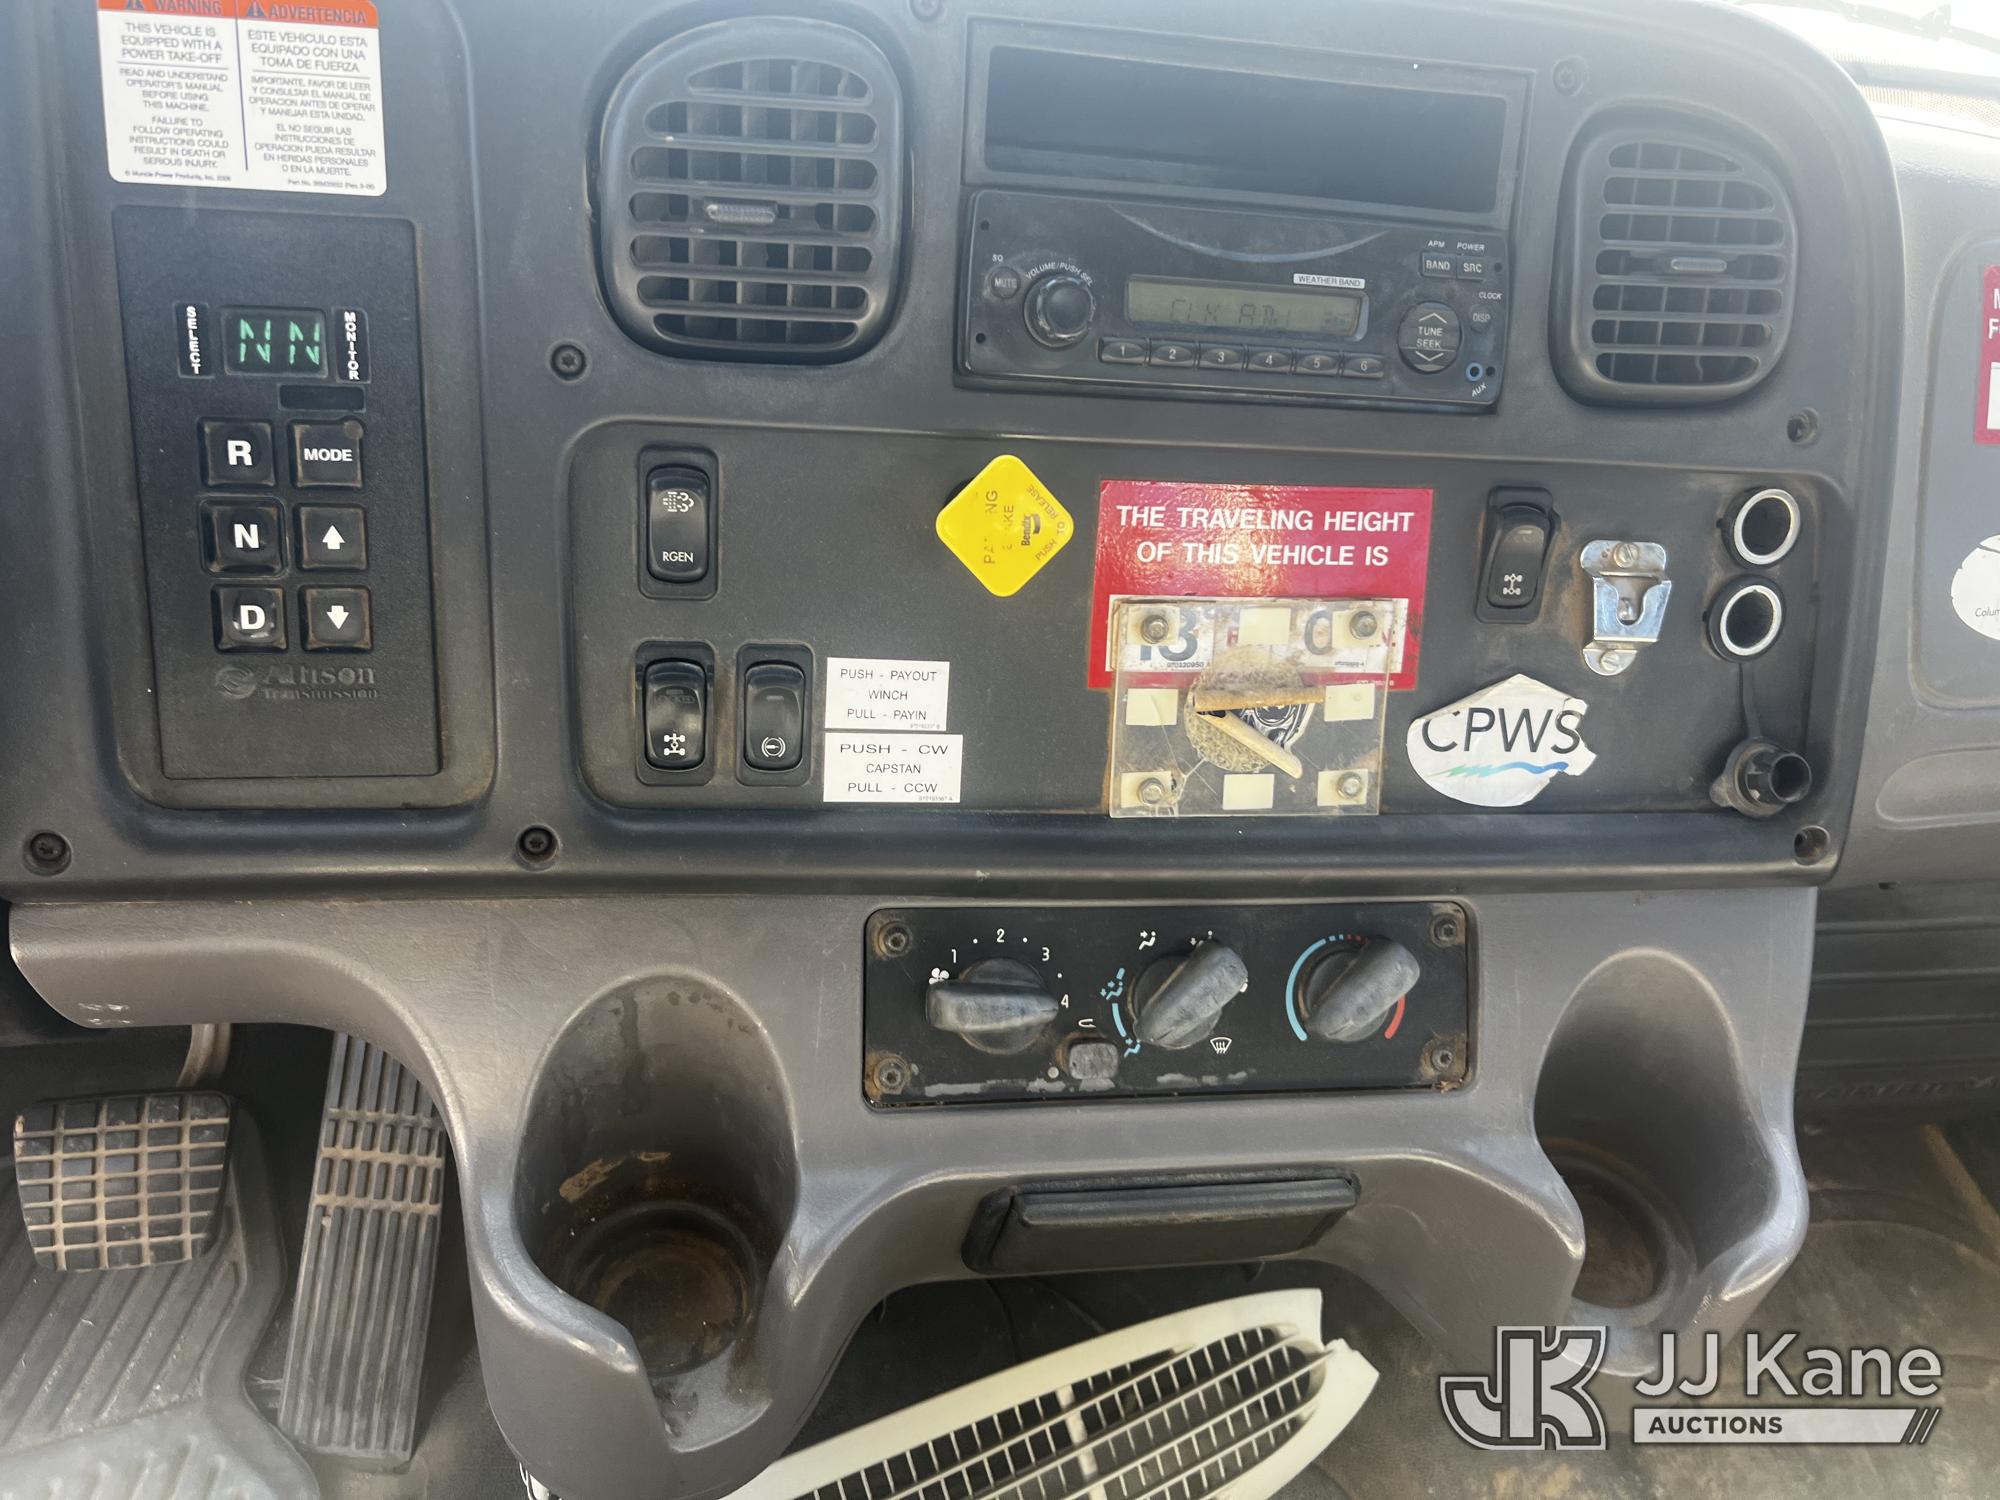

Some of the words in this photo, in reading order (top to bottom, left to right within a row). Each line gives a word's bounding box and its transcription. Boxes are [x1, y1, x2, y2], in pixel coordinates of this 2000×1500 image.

[270, 4, 367, 23] ADVERTENCIA
[125, 22, 152, 34] THIS
[154, 23, 201, 37] VEHICLE
[205, 26, 216, 38] IS
[120, 35, 180, 48] EQUIPPED
[183, 38, 211, 50] WITH
[214, 40, 222, 51] A
[248, 29, 277, 41] ESTE
[340, 36, 368, 48] ESTA
[121, 48, 165, 60] POWER
[166, 51, 222, 64] TAKE-OFF
[251, 43, 310, 57] EQUIPADO
[313, 46, 338, 58] CON
[341, 49, 366, 61] UNA
[260, 56, 294, 68] TOMA
[297, 59, 312, 69] DE
[315, 60, 360, 73] FUERZA
[120, 68, 144, 77] READ
[146, 69, 165, 79] AND
[167, 71, 228, 82] UNDERSTAND
[126, 79, 182, 90] OPERATOR'S
[185, 82, 223, 92] MANUAL
[308, 79, 335, 89] FAVOR
[337, 80, 348, 90] DE
[349, 82, 370, 92] LEER
[142, 90, 178, 100] BEFORE
[180, 91, 209, 102] USING
[252, 87, 258, 95] Y
[260, 87, 309, 97] CONSULTAR
[311, 89, 321, 98] EL
[323, 90, 356, 100] MANUAL
[359, 92, 370, 102] DE
[142, 100, 163, 109] THIS
[249, 96, 299, 107] OPERACION
[300, 99, 327, 109] ANTES
[328, 100, 339, 110] DE
[341, 101, 376, 112] OPERAR
[260, 107, 266, 115] Y
[268, 107, 309, 117] MANEJAR
[310, 110, 330, 119] ESTA
[332, 111, 365, 121] UNIDAD.
[152, 116, 188, 126] FAILURE
[191, 118, 203, 127] TO
[133, 125, 170, 135] FOLLOW
[172, 127, 223, 138] OPERATING
[276, 123, 286, 132] EL
[289, 124, 301, 133] NO
[303, 125, 334, 135] SEGUIR
[336, 127, 352, 136] LAS
[129, 136, 195, 147] INSTRUCTIONS
[197, 138, 229, 149] COULD
[275, 133, 341, 145] INSTRUCCIONES
[344, 137, 355, 146] DE
[134, 146, 167, 155] RESULT
[170, 147, 179, 156] IN
[181, 148, 210, 158] DEATH
[211, 149, 226, 159] OR
[254, 142, 303, 153] OPERACION
[305, 144, 334, 155] PUEDA
[335, 146, 376, 158] RESULTAR
[143, 157, 182, 167] SERIOUS
[264, 153, 275, 162] EN
[277, 153, 312, 164] HERIDAS
[314, 156, 369, 167] PERSONALES
[281, 164, 289, 172] O
[291, 165, 302, 173] EN
[303, 166, 314, 175] LA
[1457, 242, 1485, 251] POWER
[992, 254, 1004, 263] SQ
[1426, 260, 1450, 271] BAND
[1463, 262, 1482, 273] SRC
[994, 278, 1019, 289] MUTE
[1298, 275, 1337, 286] WEATHER
[1338, 278, 1361, 288] BAND
[1479, 291, 1502, 300] CLOCK
[1472, 312, 1491, 322] DISP
[1418, 326, 1443, 337] TUNE
[186, 305, 201, 375] SELECT
[344, 311, 360, 381] MONITOR
[1416, 338, 1442, 349] SEEK
[1120, 345, 1125, 356] 1
[1169, 349, 1176, 360] 2
[1217, 351, 1225, 363] 3
[1265, 354, 1273, 366] 4
[1313, 357, 1321, 369] 5
[1360, 360, 1368, 372] 6
[1470, 382, 1488, 397] AUX
[227, 439, 253, 466] R
[303, 448, 353, 462] MODE
[1025, 484, 1060, 520] RELEASE
[1116, 504, 1165, 527] THE
[1177, 507, 1313, 531] TRAVELING
[1323, 511, 1415, 533] HEIGHT
[233, 523, 260, 549] N
[1035, 538, 1057, 561] PUSH
[1057, 520, 1065, 535] TO
[662, 551, 694, 563] RGEN
[1136, 541, 1173, 563] OF
[1183, 543, 1239, 564] THIS
[1251, 544, 1354, 566] VEHICLE
[1365, 545, 1389, 567] IS
[239, 604, 267, 630] D
[840, 668, 874, 679] PUSH
[890, 670, 937, 681] PAYOUT
[868, 690, 908, 700] WINCH
[847, 708, 876, 719] PULL
[893, 709, 927, 720] PAYIN
[1422, 707, 1583, 754] CPWS
[840, 744, 891, 754] PUSH
[918, 745, 949, 755] CW
[866, 763, 921, 774] CAPSTAN
[848, 782, 882, 793] PULL
[904, 783, 938, 793] CCW
[996, 928, 1005, 944] 2
[951, 949, 957, 963] 1
[1042, 947, 1051, 961] 3
[1060, 995, 1070, 1009] 4
